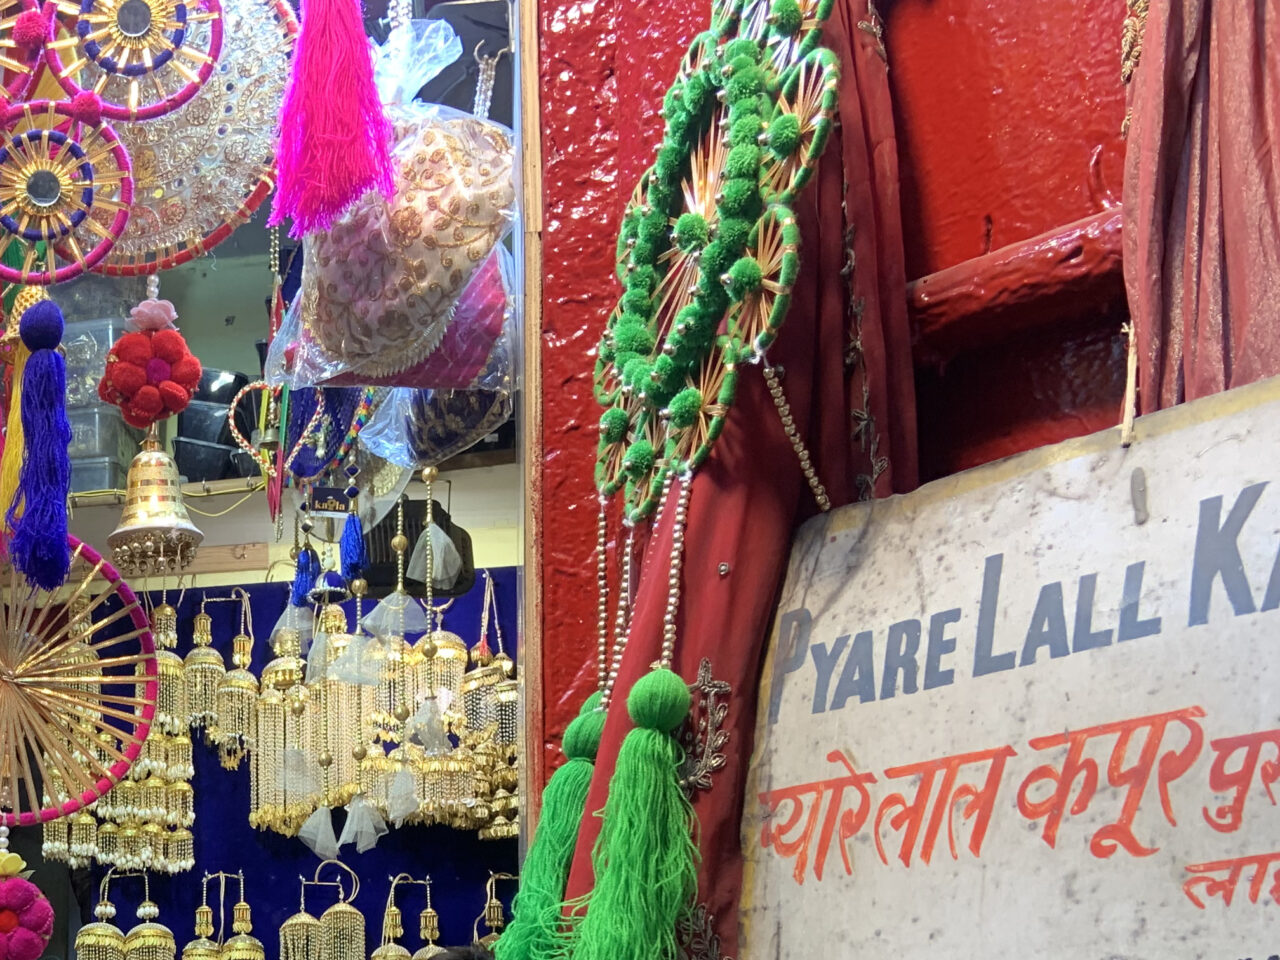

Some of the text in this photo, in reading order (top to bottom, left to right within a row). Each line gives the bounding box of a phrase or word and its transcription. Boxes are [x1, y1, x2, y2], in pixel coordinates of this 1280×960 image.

[769, 608, 961, 725] PYARE
[972, 553, 1162, 678] LALL
[1017, 705, 1207, 858] कपूर
